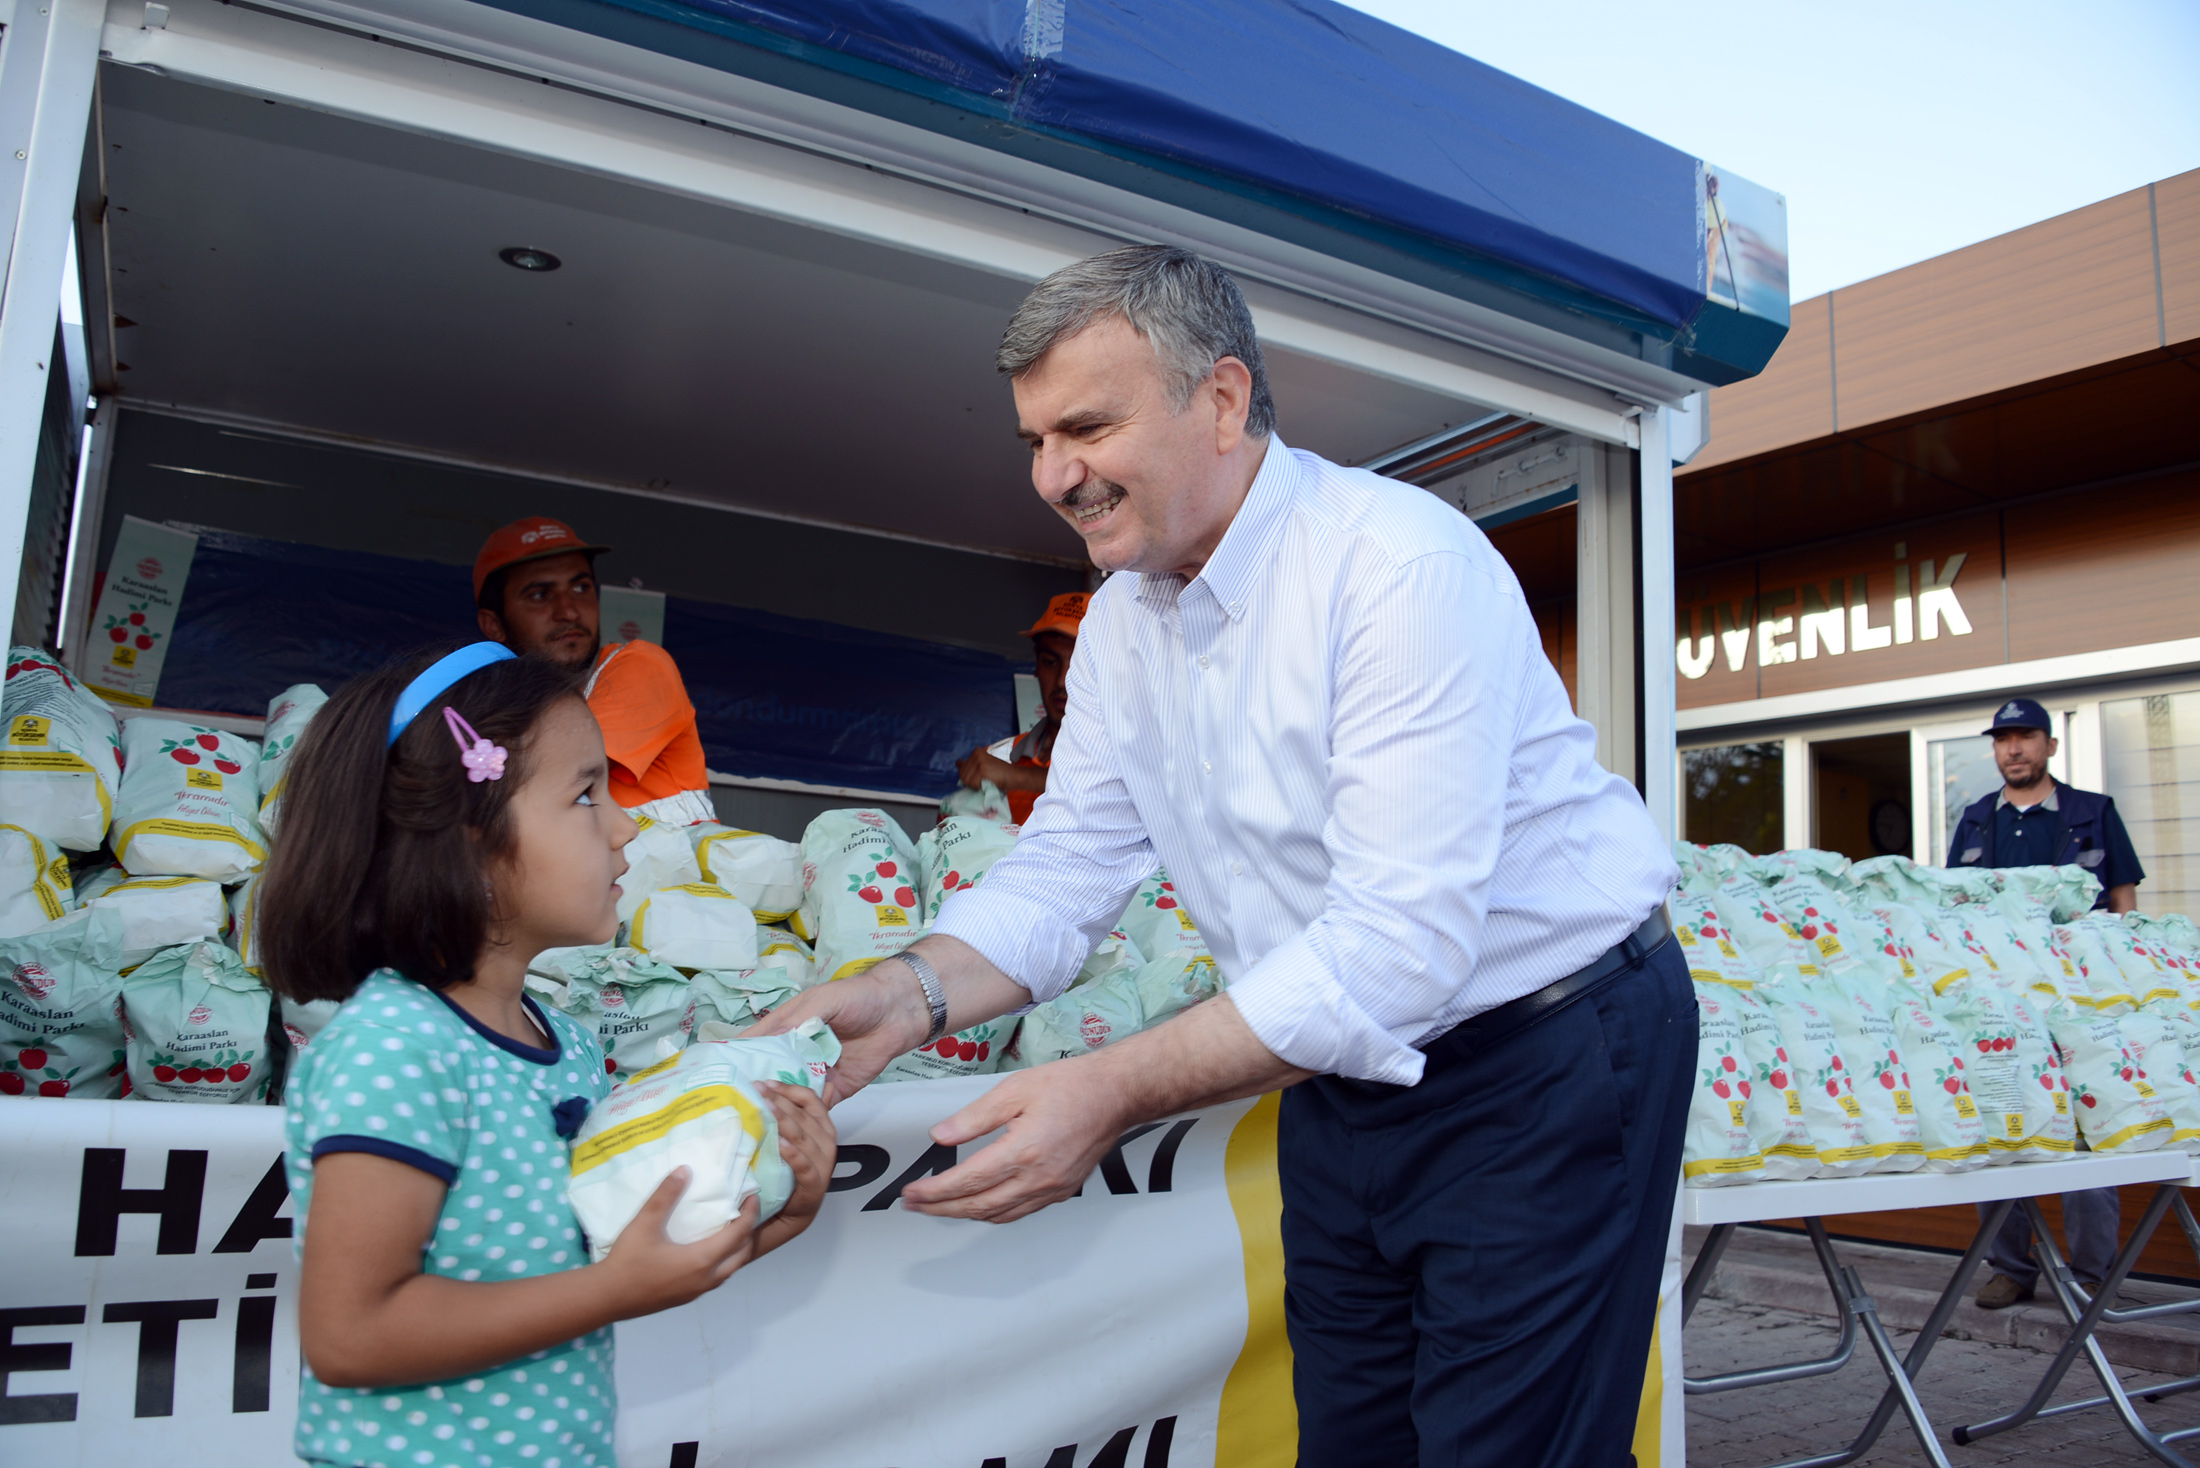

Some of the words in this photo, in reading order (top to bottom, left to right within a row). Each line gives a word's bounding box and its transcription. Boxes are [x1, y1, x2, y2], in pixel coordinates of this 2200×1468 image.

[1677, 542, 1973, 679] ÜVENLİK
[942, 831, 972, 850] Parkı
[1, 991, 74, 1020] Karaaslan
[0, 1012, 37, 1033] adimi
[42, 1022, 85, 1035] Parkı
[613, 1022, 649, 1035] Parkı
[1700, 1018, 1736, 1028] araaslan
[166, 1041, 206, 1052] Hadimi
[209, 1040, 238, 1050] Parkı
[176, 1030, 229, 1042] Karaaslan
[74, 1148, 294, 1257] HA
[0, 1273, 278, 1425] ETİ
